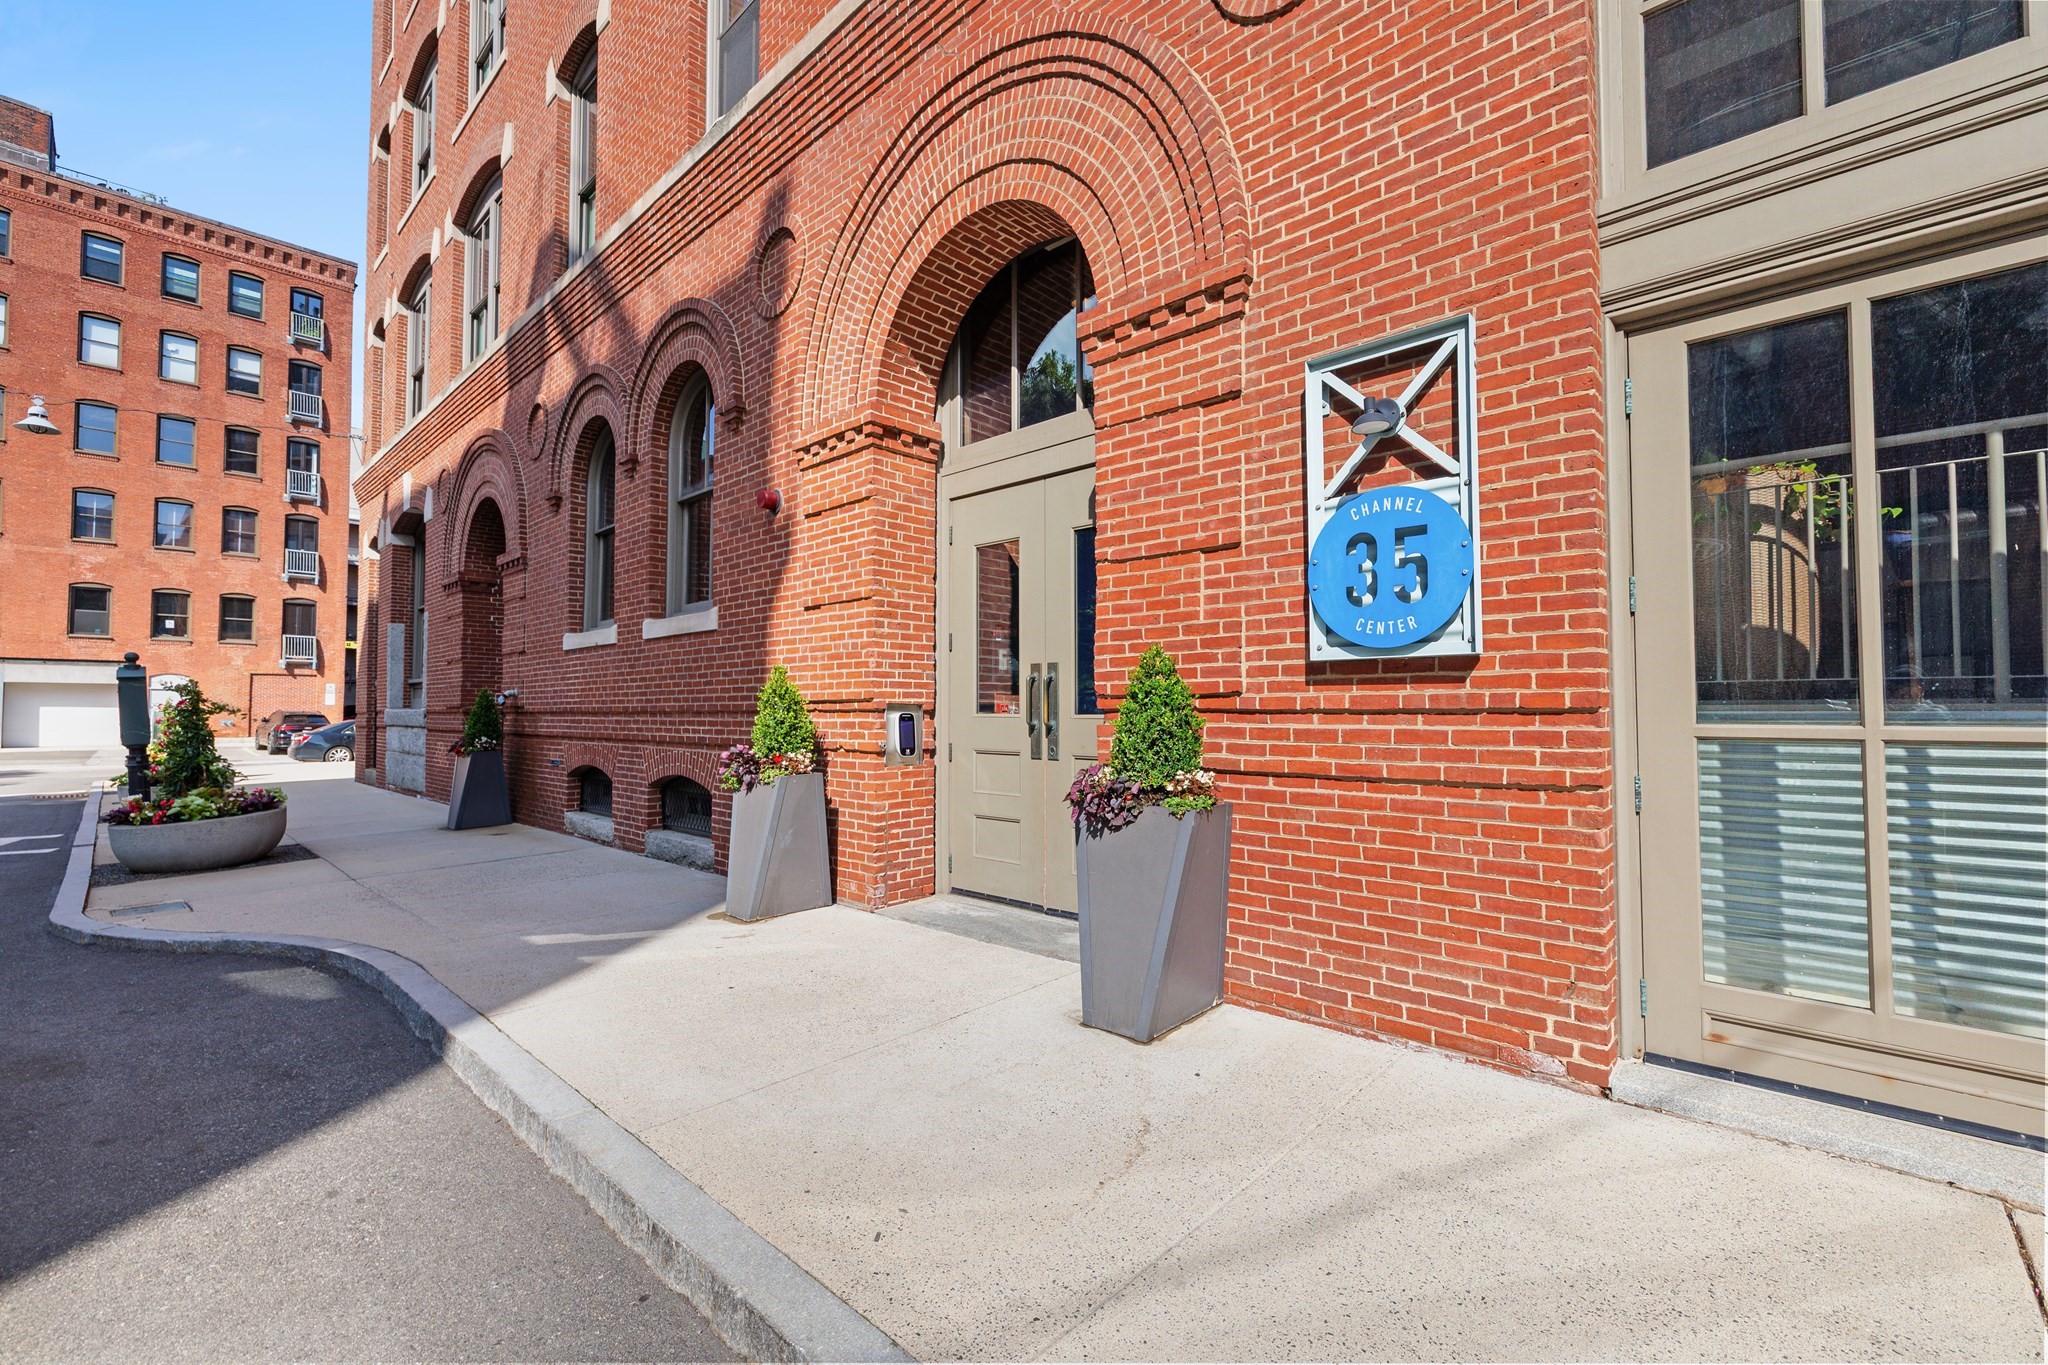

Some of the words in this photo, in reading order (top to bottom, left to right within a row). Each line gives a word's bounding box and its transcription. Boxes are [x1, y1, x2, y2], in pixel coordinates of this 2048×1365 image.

[1350, 497, 1423, 521] CHANNEL
[1345, 524, 1428, 608] 35
[1355, 615, 1418, 635] CENTER
